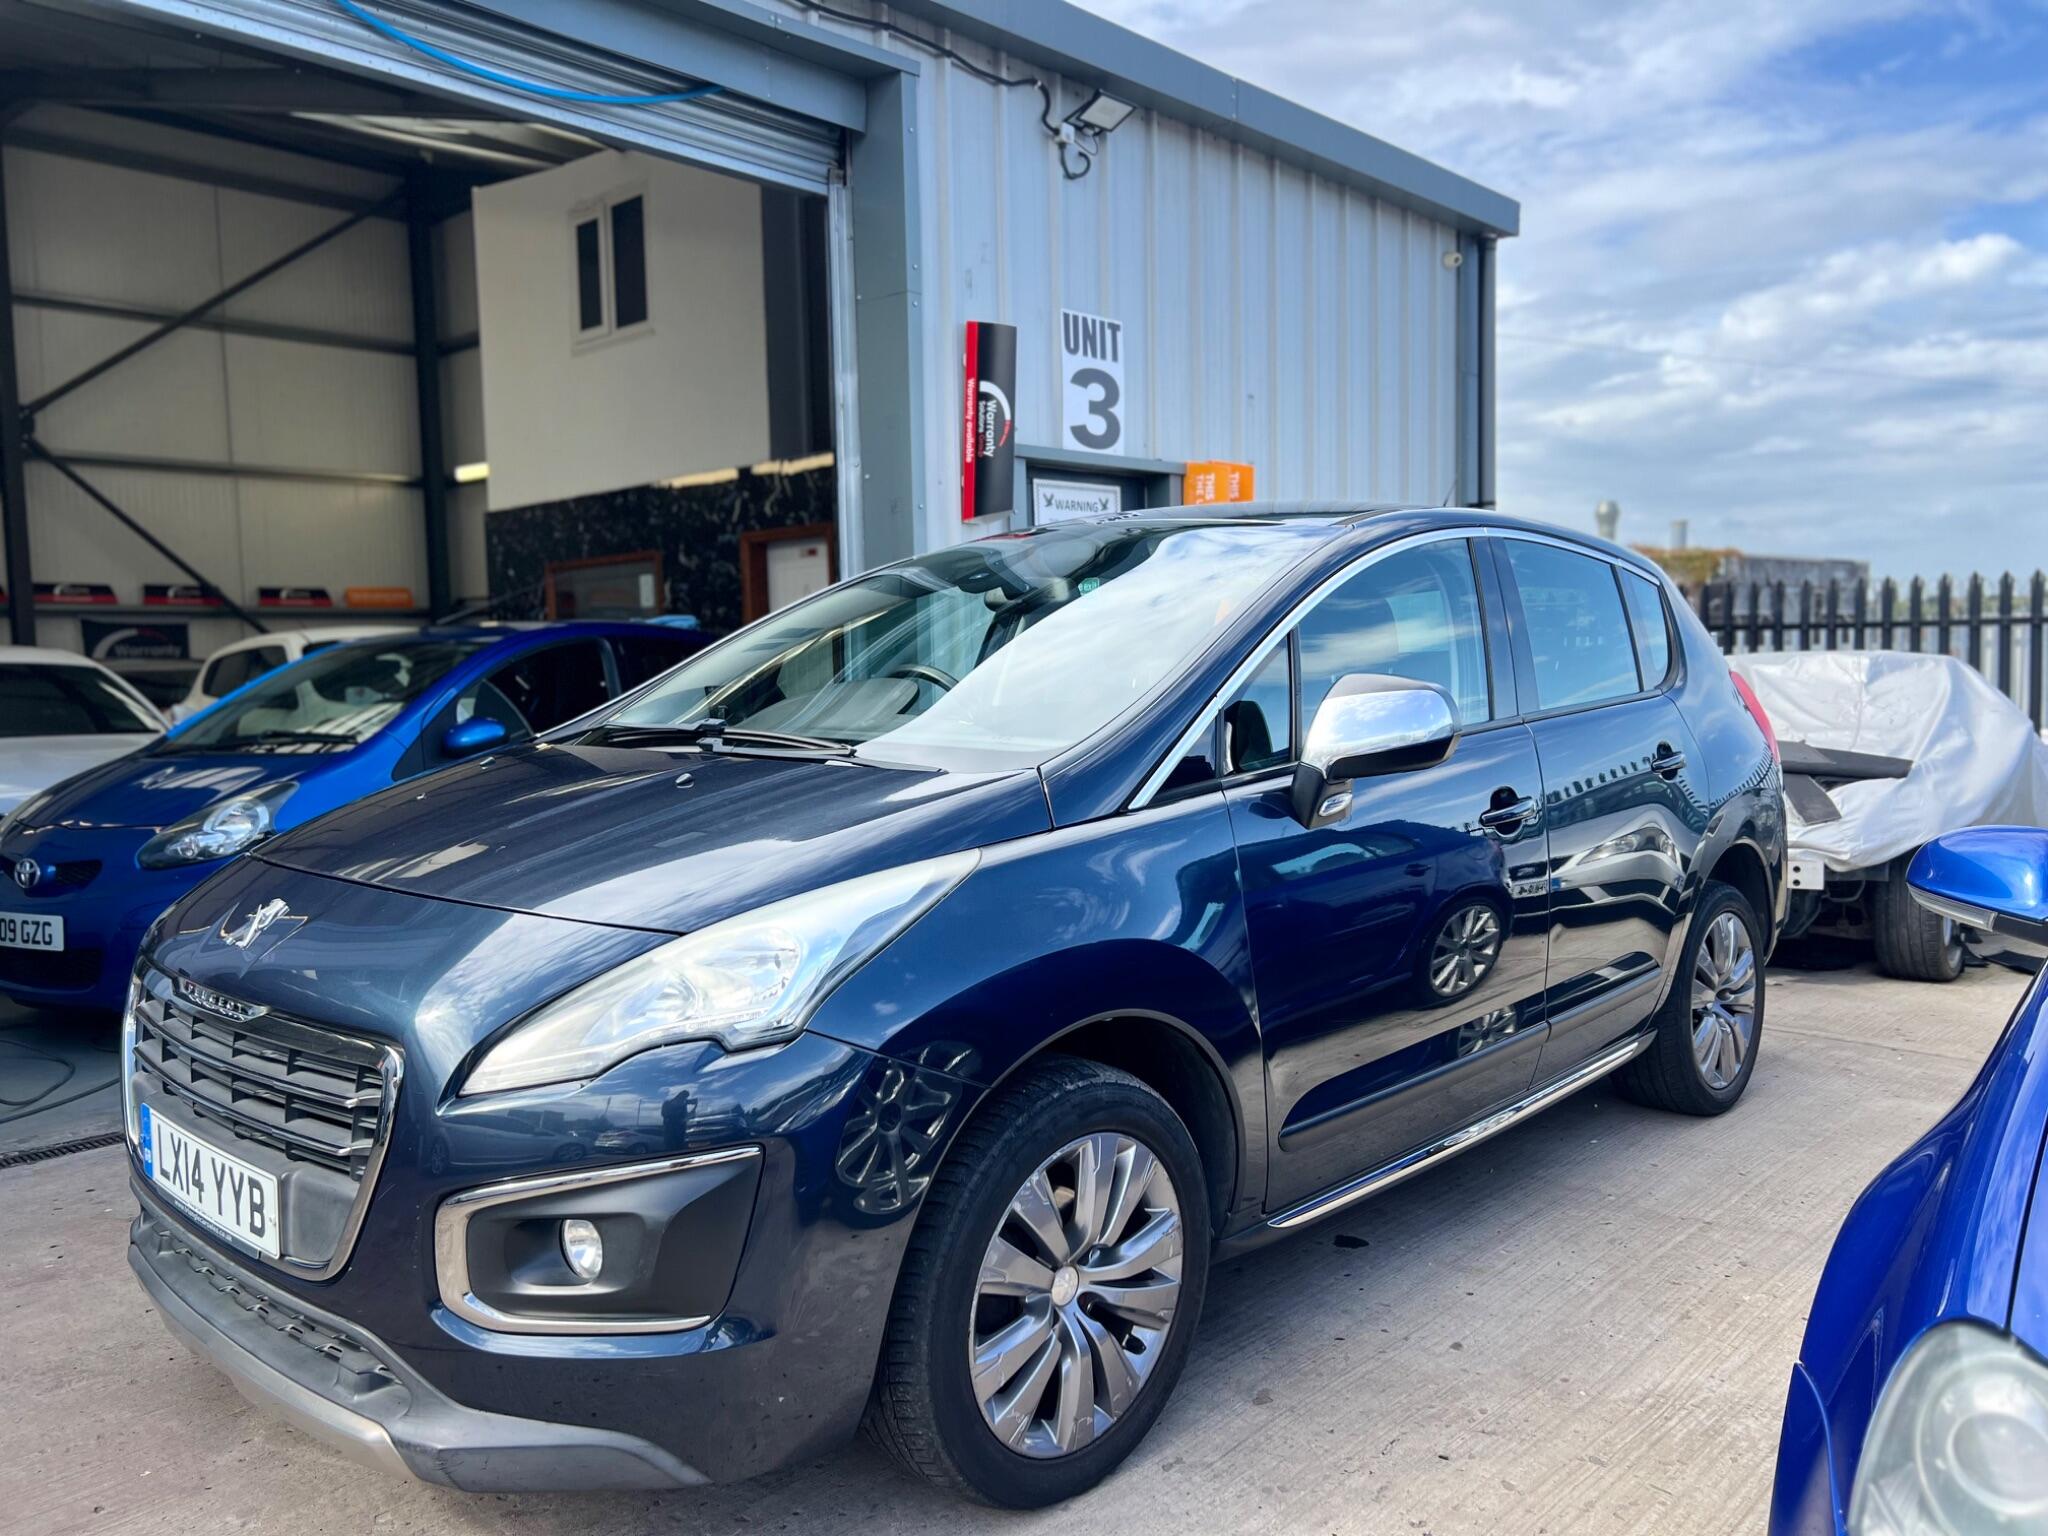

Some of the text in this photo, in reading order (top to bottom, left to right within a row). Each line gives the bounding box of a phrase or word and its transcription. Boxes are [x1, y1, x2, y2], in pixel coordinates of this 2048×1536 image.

[1062, 311, 1121, 363] UNIT
[965, 378, 975, 463] Warranty available
[983, 399, 997, 457] Warranty
[1069, 367, 1121, 450] 3
[1055, 499, 1099, 512] WARNING
[21, 919, 53, 946] GZG
[158, 1123, 266, 1239] LX14 YYB
